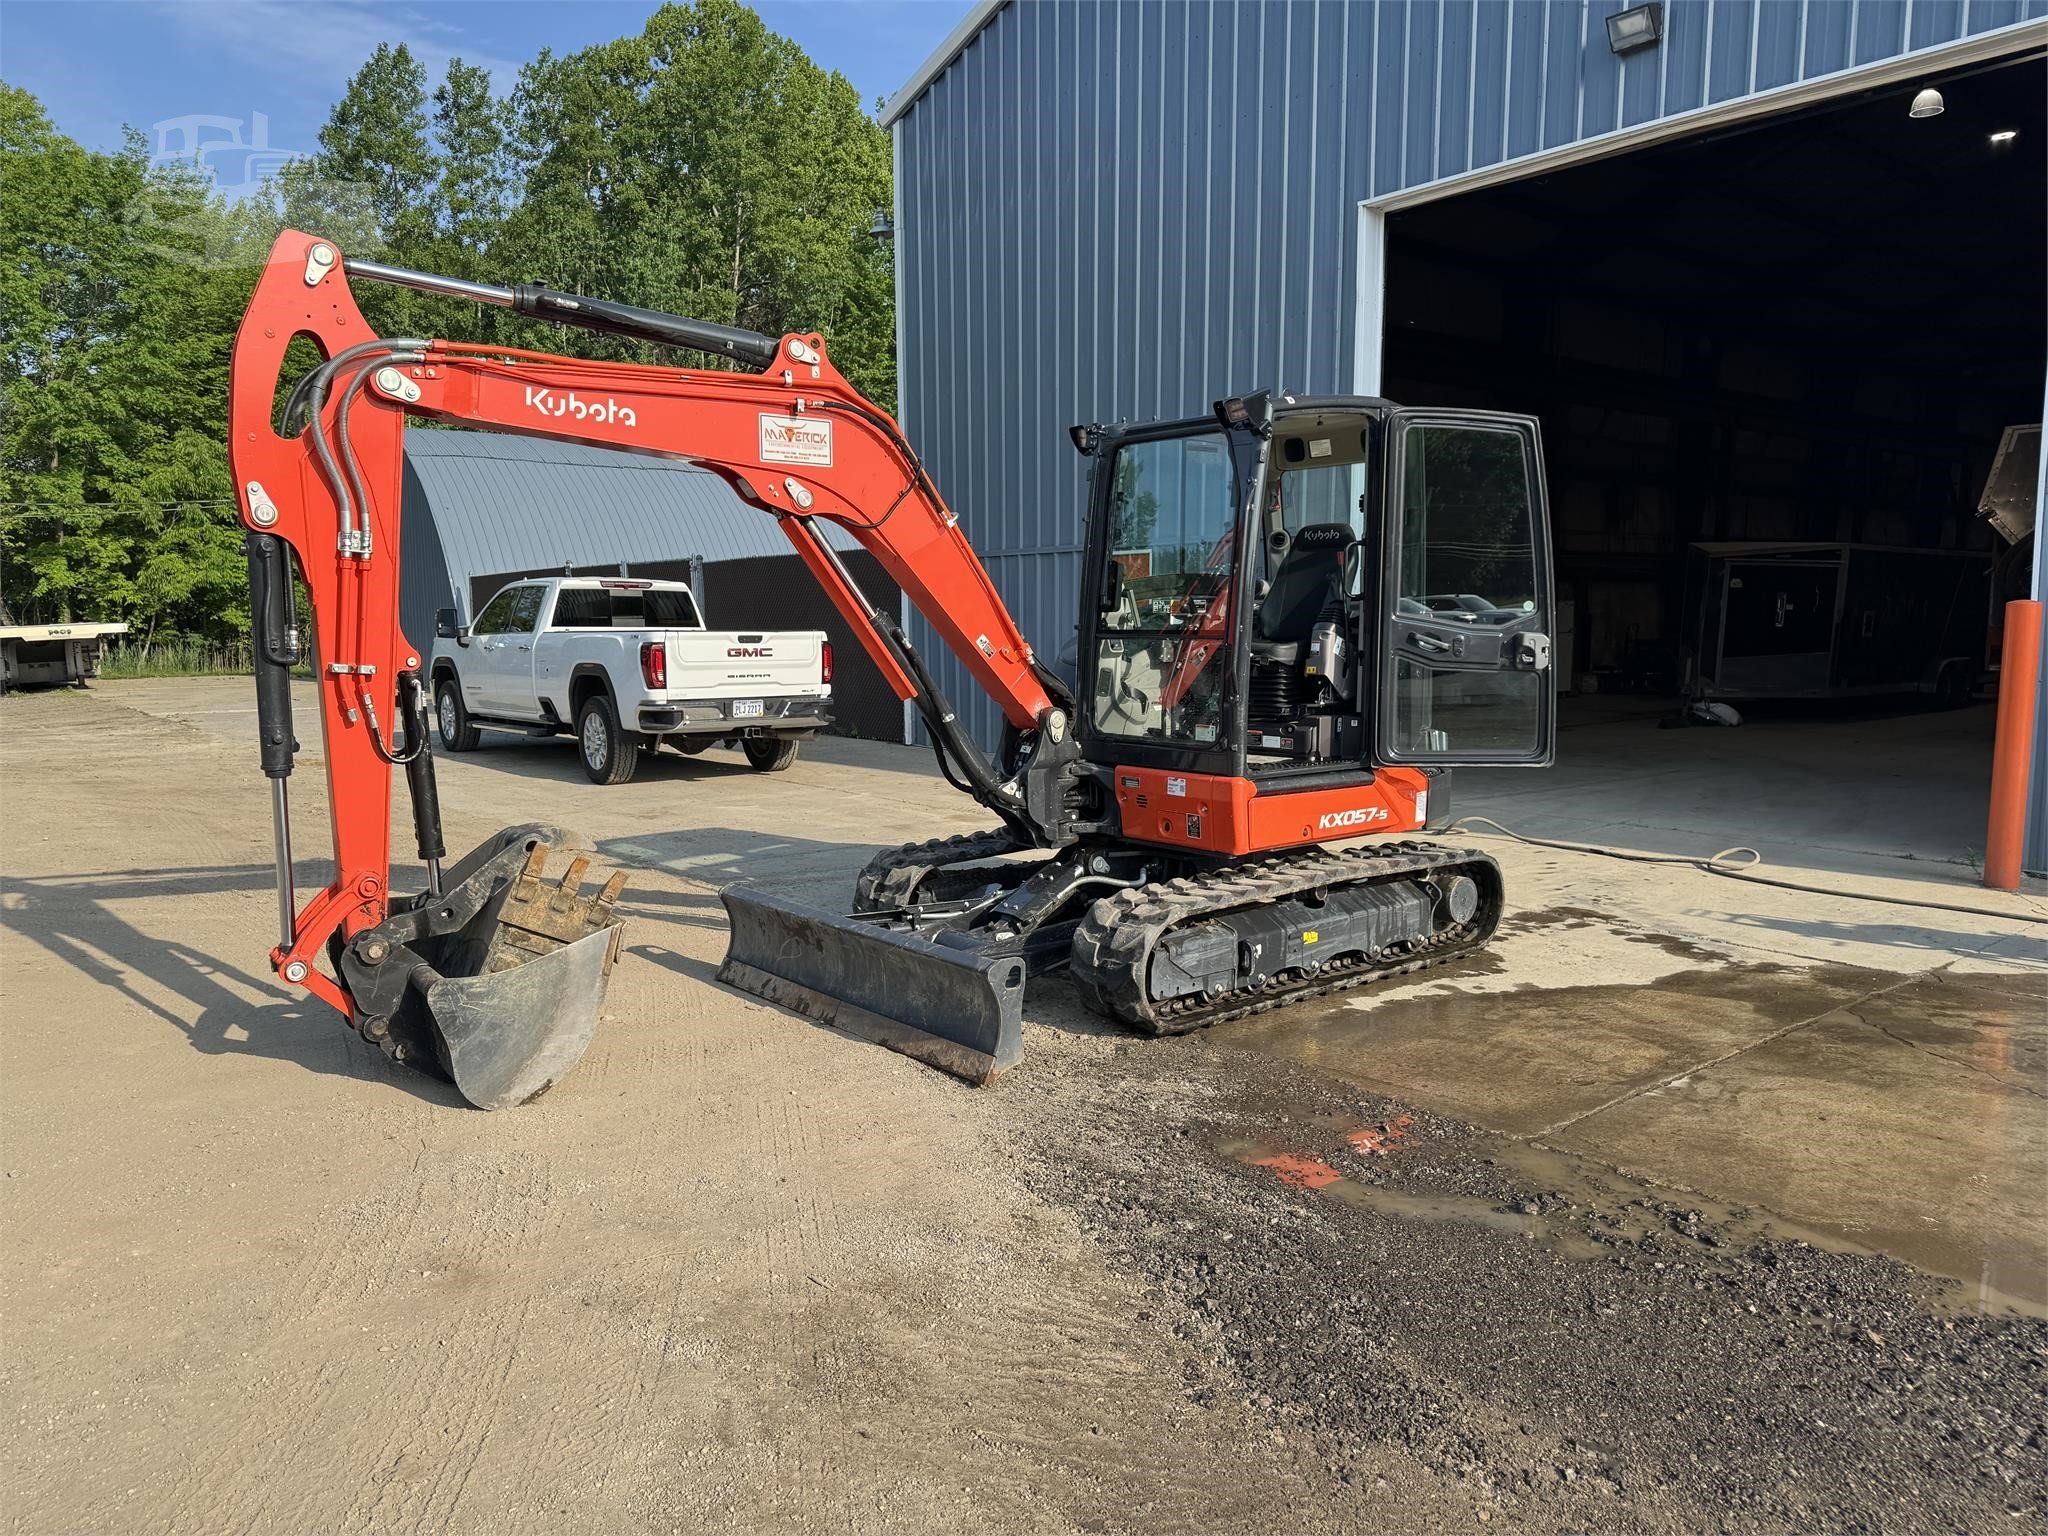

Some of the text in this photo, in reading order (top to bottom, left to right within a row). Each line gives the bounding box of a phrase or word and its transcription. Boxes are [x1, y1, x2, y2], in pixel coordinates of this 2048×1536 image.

[525, 386, 636, 427] Kubota
[764, 427, 827, 445] MAVERICK
[1304, 529, 1340, 540] Kubota
[727, 647, 773, 657] GMC
[1318, 806, 1389, 829] KX057-5
